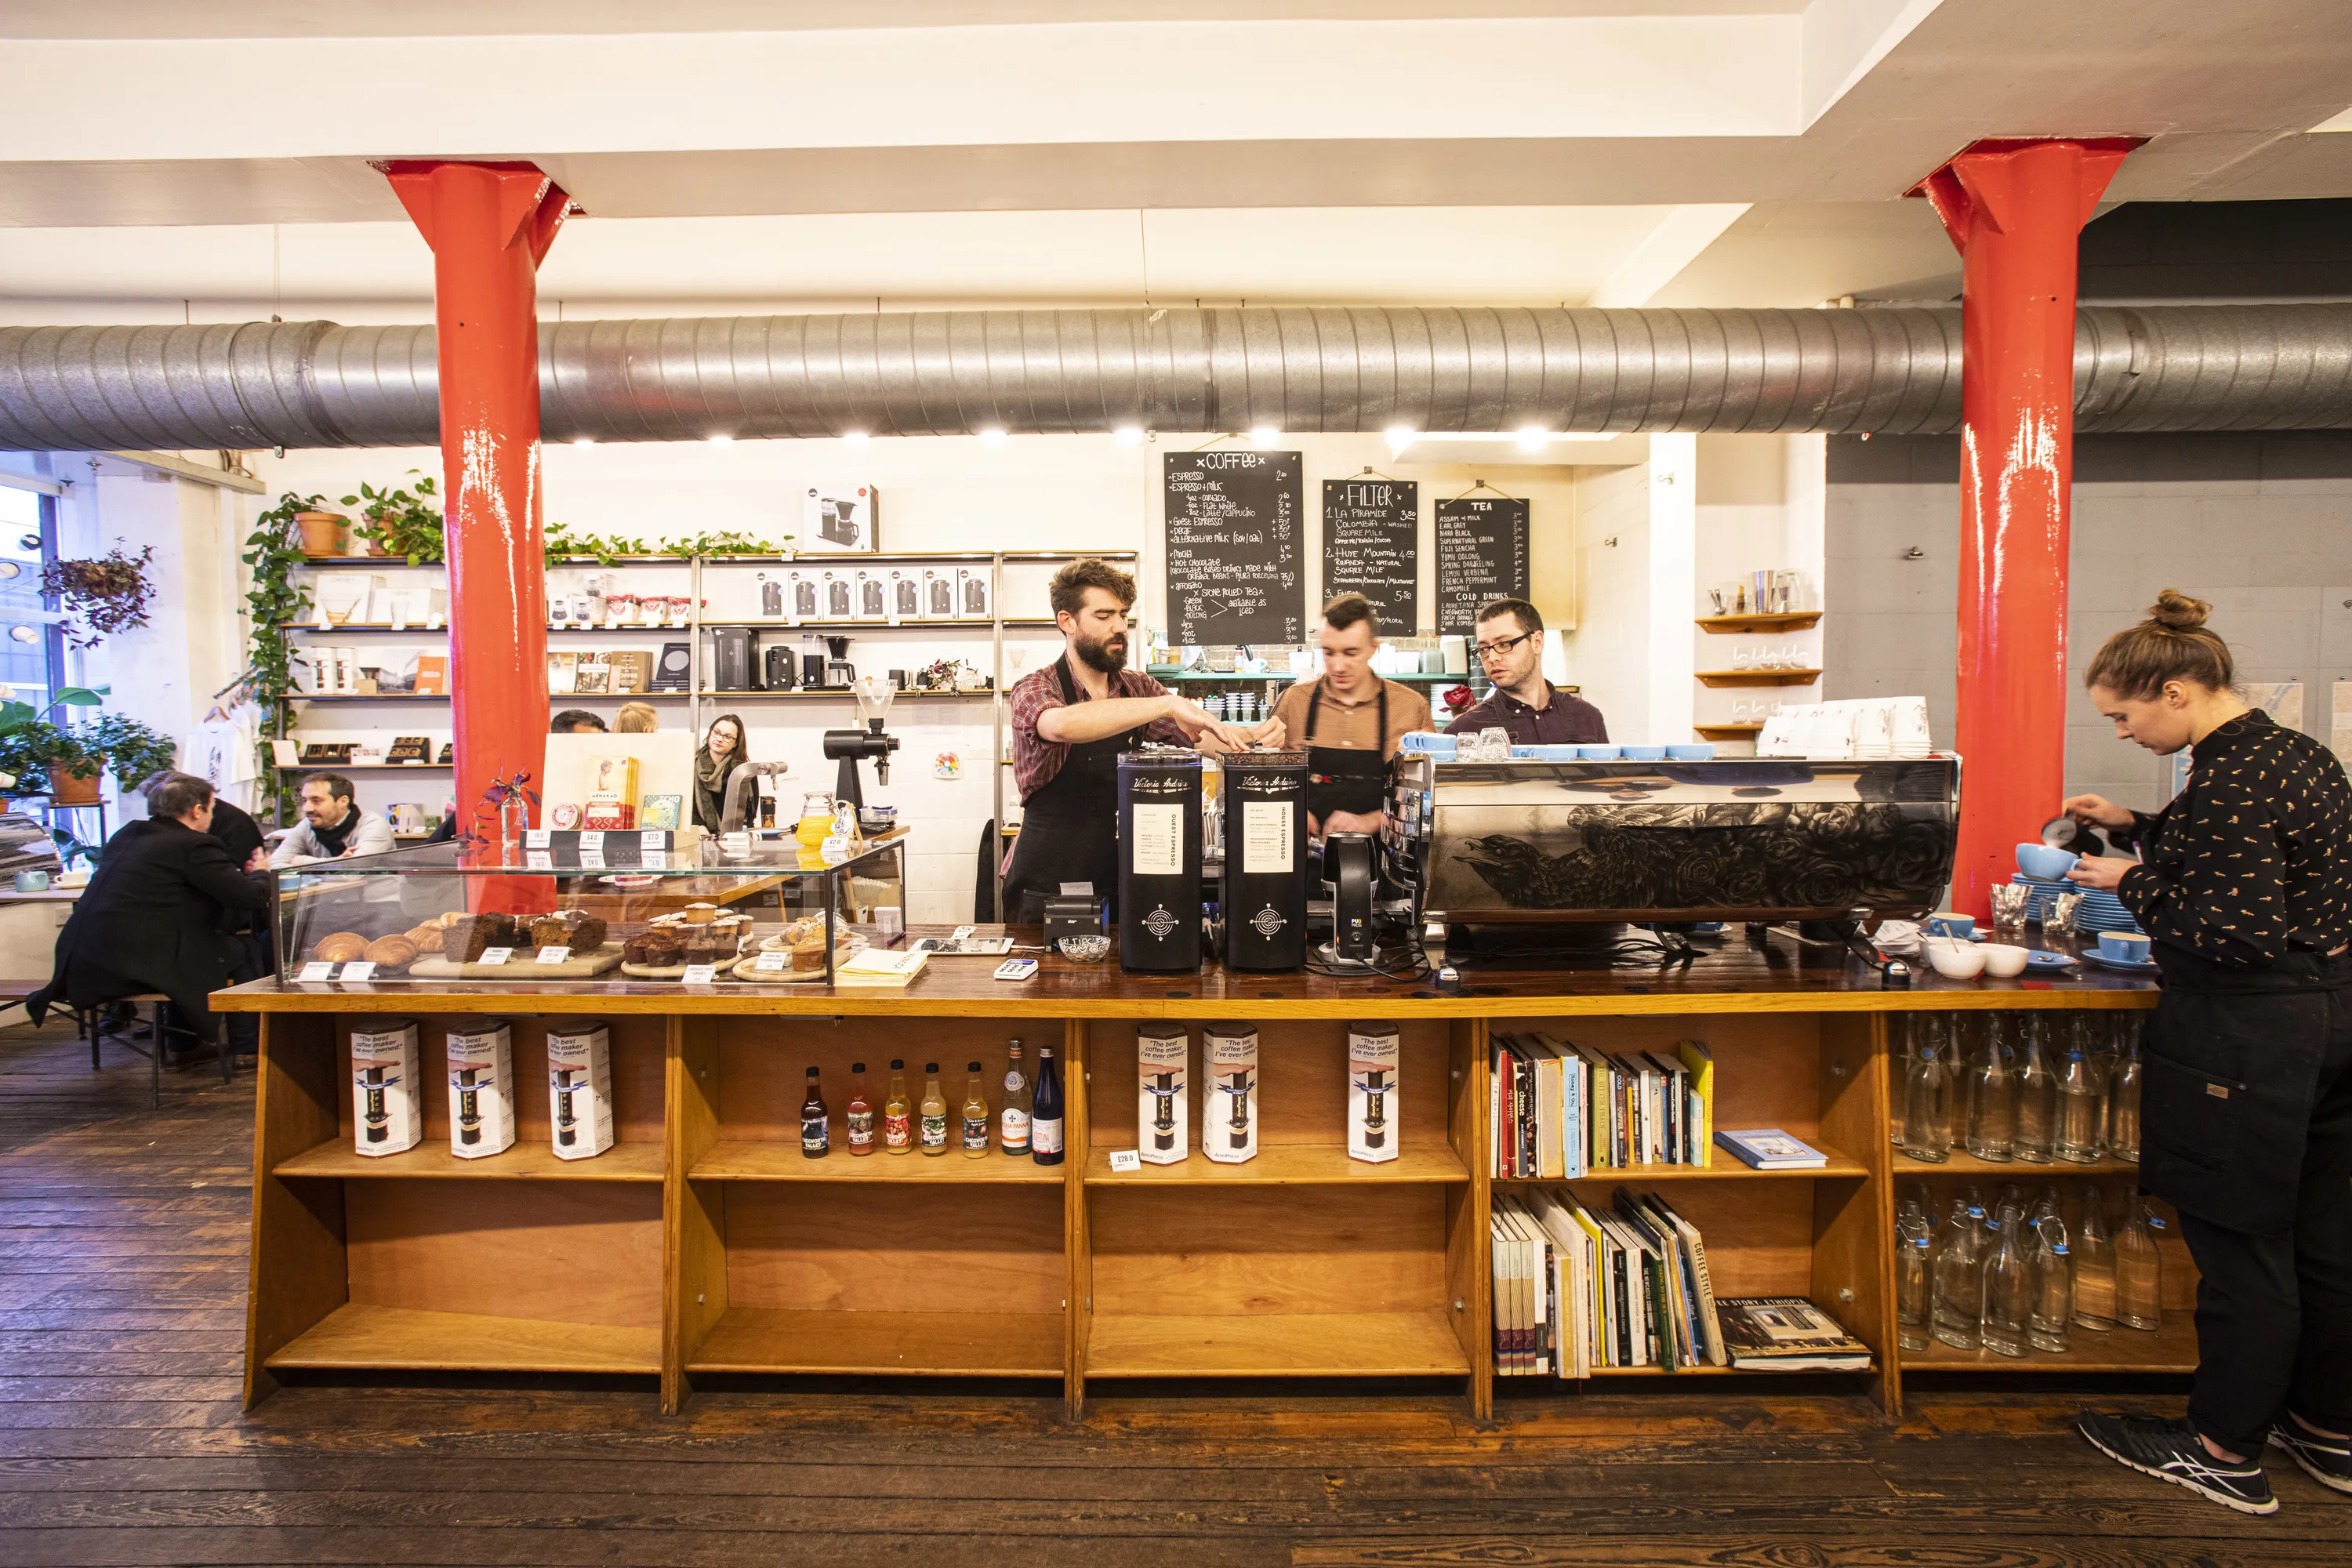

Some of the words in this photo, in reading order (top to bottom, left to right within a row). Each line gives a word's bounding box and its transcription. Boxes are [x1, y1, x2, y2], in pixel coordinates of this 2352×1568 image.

[1471, 503, 1492, 511] TEA
[1335, 547, 1358, 557] HUYE
[1463, 560, 1495, 568] DARJEELING
[1334, 566, 1363, 575] SQUARE
[1456, 593, 1477, 601] COLD
[1695, 1243, 1706, 1272] COFFEE
[1700, 1273, 1711, 1298] STYLE
